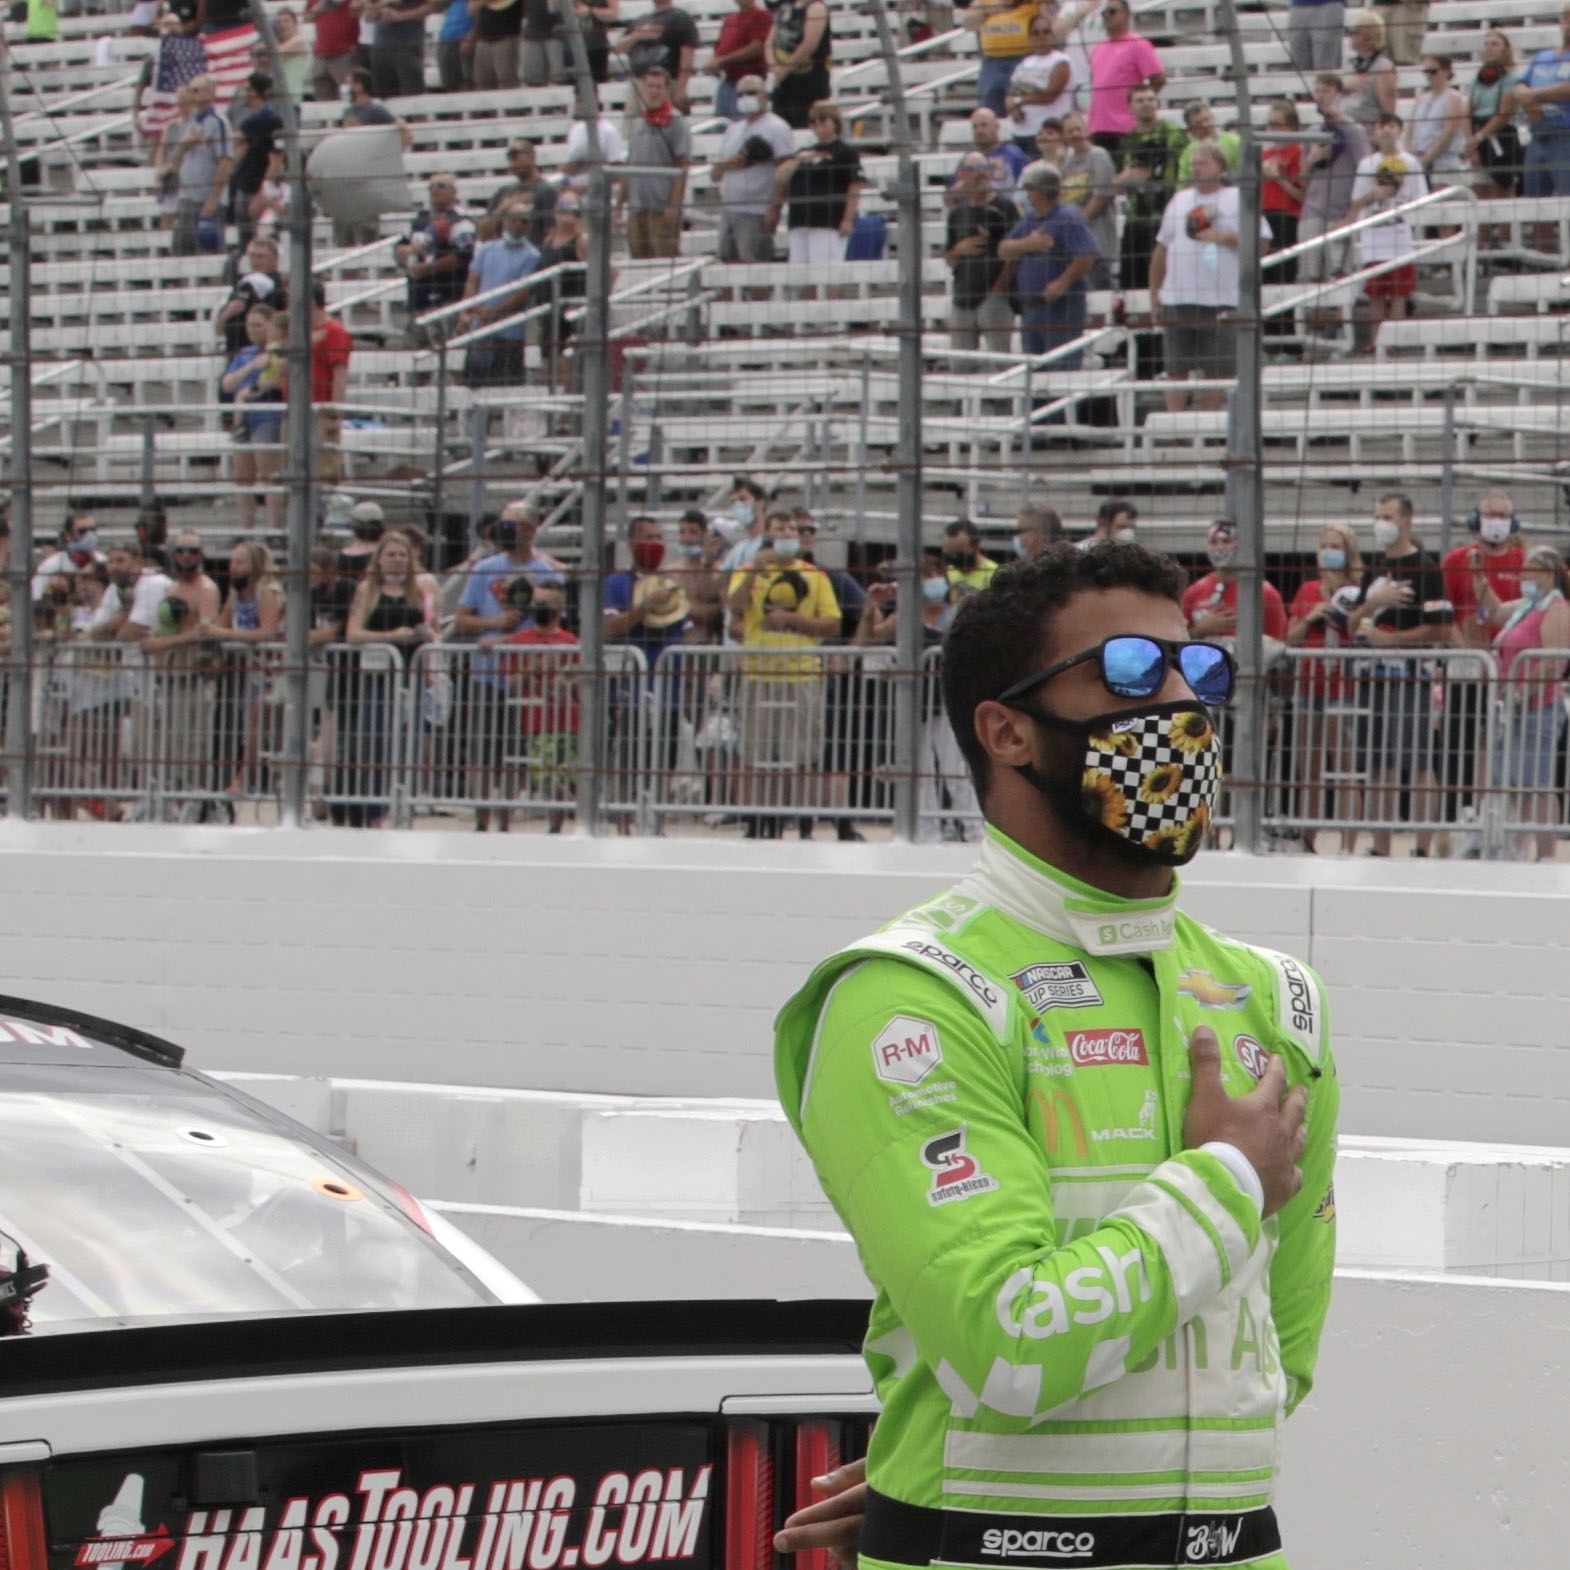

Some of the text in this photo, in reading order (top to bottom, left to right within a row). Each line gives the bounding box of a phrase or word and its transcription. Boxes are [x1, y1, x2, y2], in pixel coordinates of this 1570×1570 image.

[1119, 921, 1160, 941] Cash
[901, 940, 998, 1009] sparco
[1027, 966, 1074, 983] NASCAR
[1030, 983, 1085, 1004] UP SERIES
[881, 1033, 932, 1067] R-M
[1091, 1127, 1157, 1140] MACK
[996, 1245, 1152, 1339] Cash
[980, 1527, 1096, 1558] sparco
